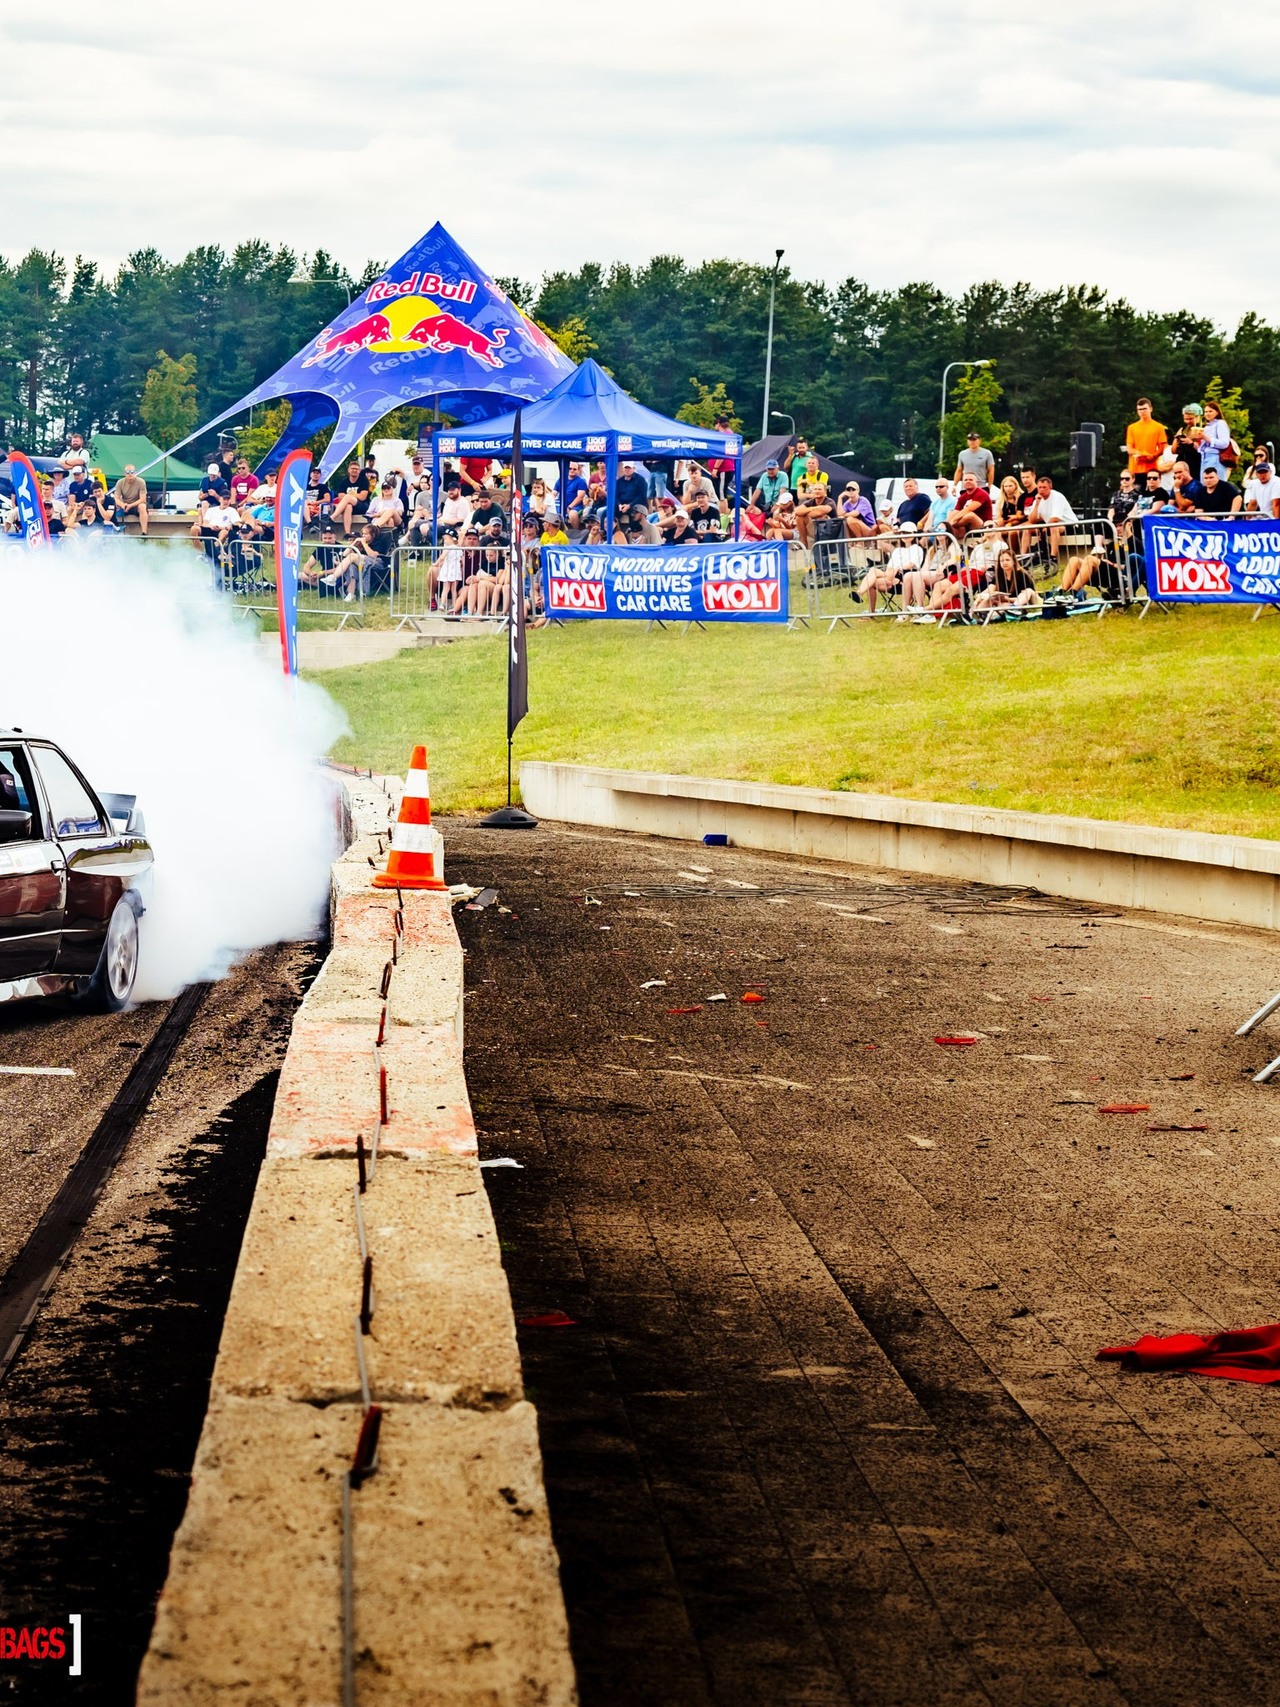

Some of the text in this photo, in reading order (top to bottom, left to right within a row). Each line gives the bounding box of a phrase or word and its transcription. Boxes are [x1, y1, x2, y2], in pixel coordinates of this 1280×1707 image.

[404, 236, 446, 273] Red Bull
[365, 272, 421, 304] Red
[420, 273, 478, 304] Bull
[460, 440, 582, 450] MOTOR OILS ADTIVES CAR CARE
[651, 439, 708, 450] www.liqui-moly.com
[1158, 530, 1223, 560] LIQUI
[1232, 532, 1280, 553] MOTO
[549, 554, 608, 581] LIQUI
[611, 557, 701, 573] MOTOR OILS
[707, 553, 777, 581] LIQUI
[1161, 561, 1227, 590] MOLY
[1236, 556, 1280, 575] ADDI
[551, 581, 604, 608] MOLY
[613, 575, 692, 593] ADDITIVES
[706, 581, 778, 609] MOLY
[1241, 575, 1278, 594] CAR
[617, 595, 693, 612] CAR CARE
